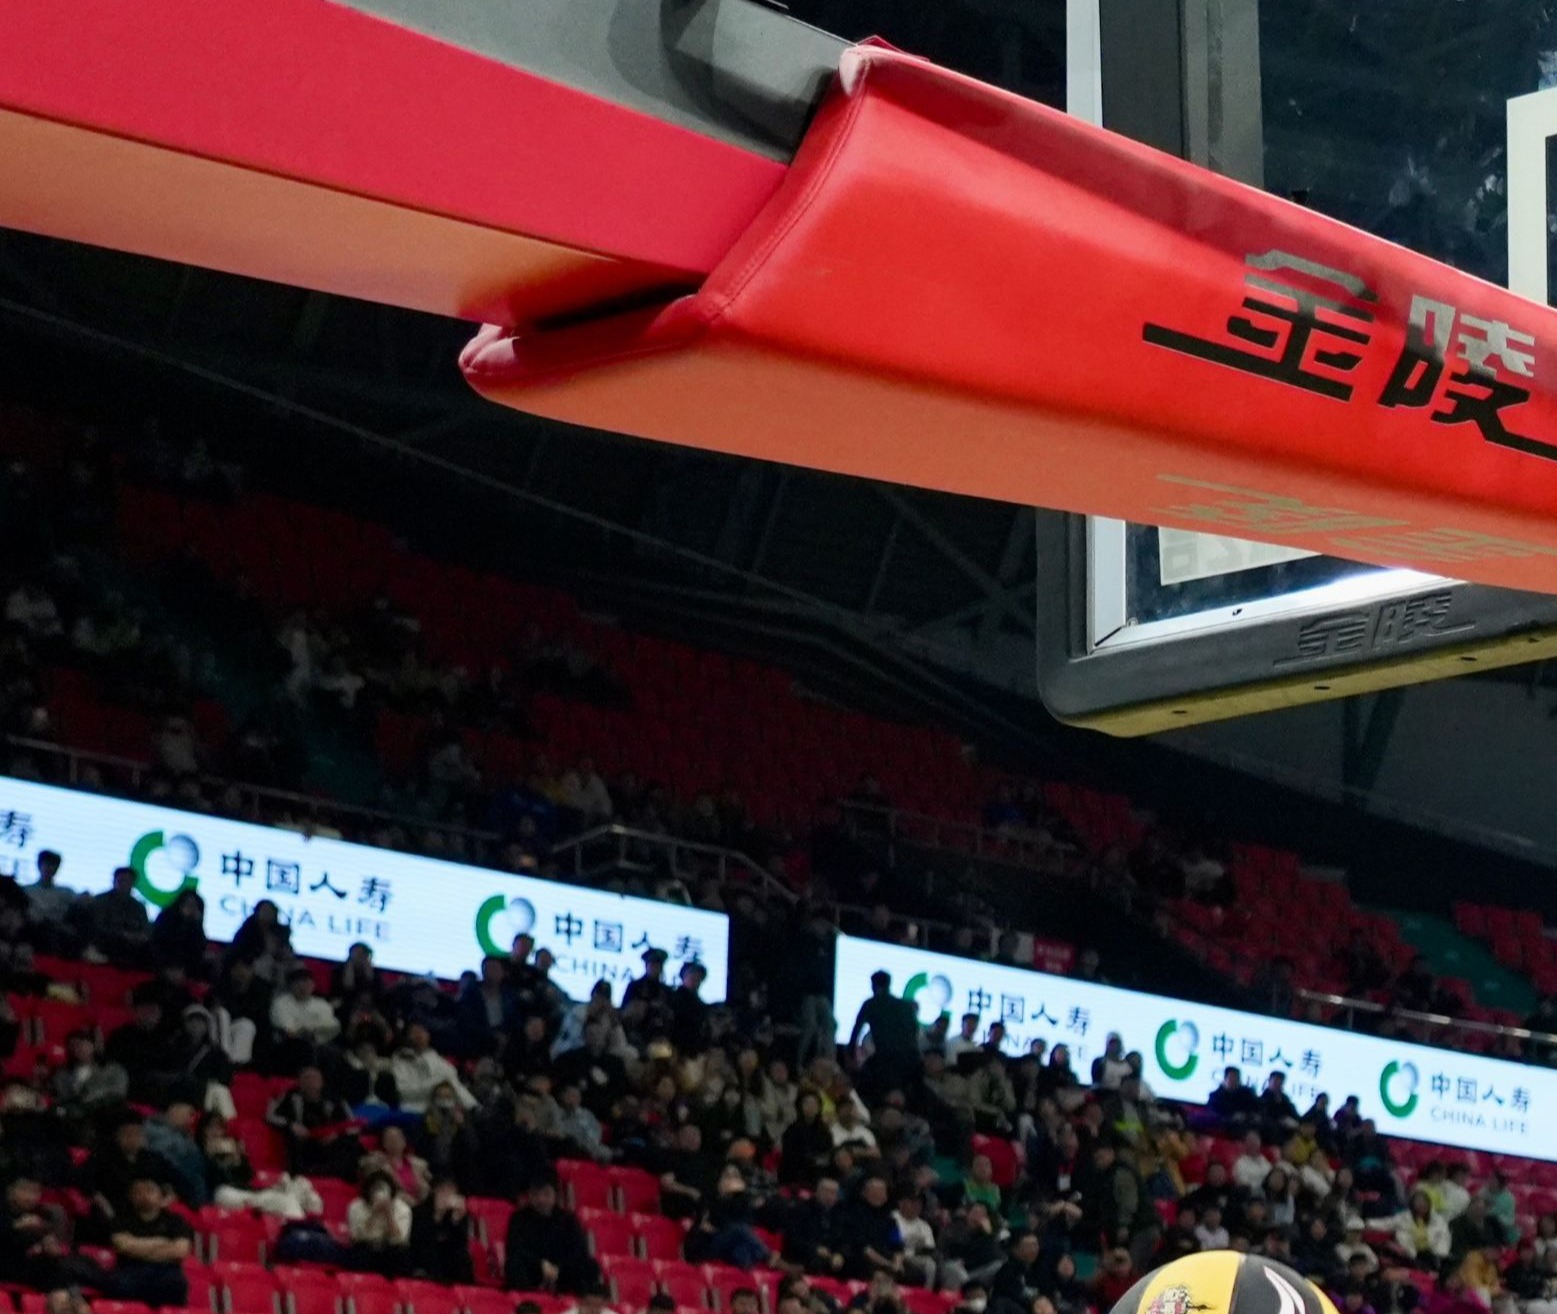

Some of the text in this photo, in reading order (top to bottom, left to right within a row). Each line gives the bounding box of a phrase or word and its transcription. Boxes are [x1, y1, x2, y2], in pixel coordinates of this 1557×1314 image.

[221, 850, 392, 913] 中国人寿
[967, 986, 1091, 1038] 中国人寿
[1213, 1031, 1324, 1079] 中国人寿
[1431, 1072, 1532, 1113] 中国人寿
[1430, 1107, 1530, 1135] CHINA LIFE
